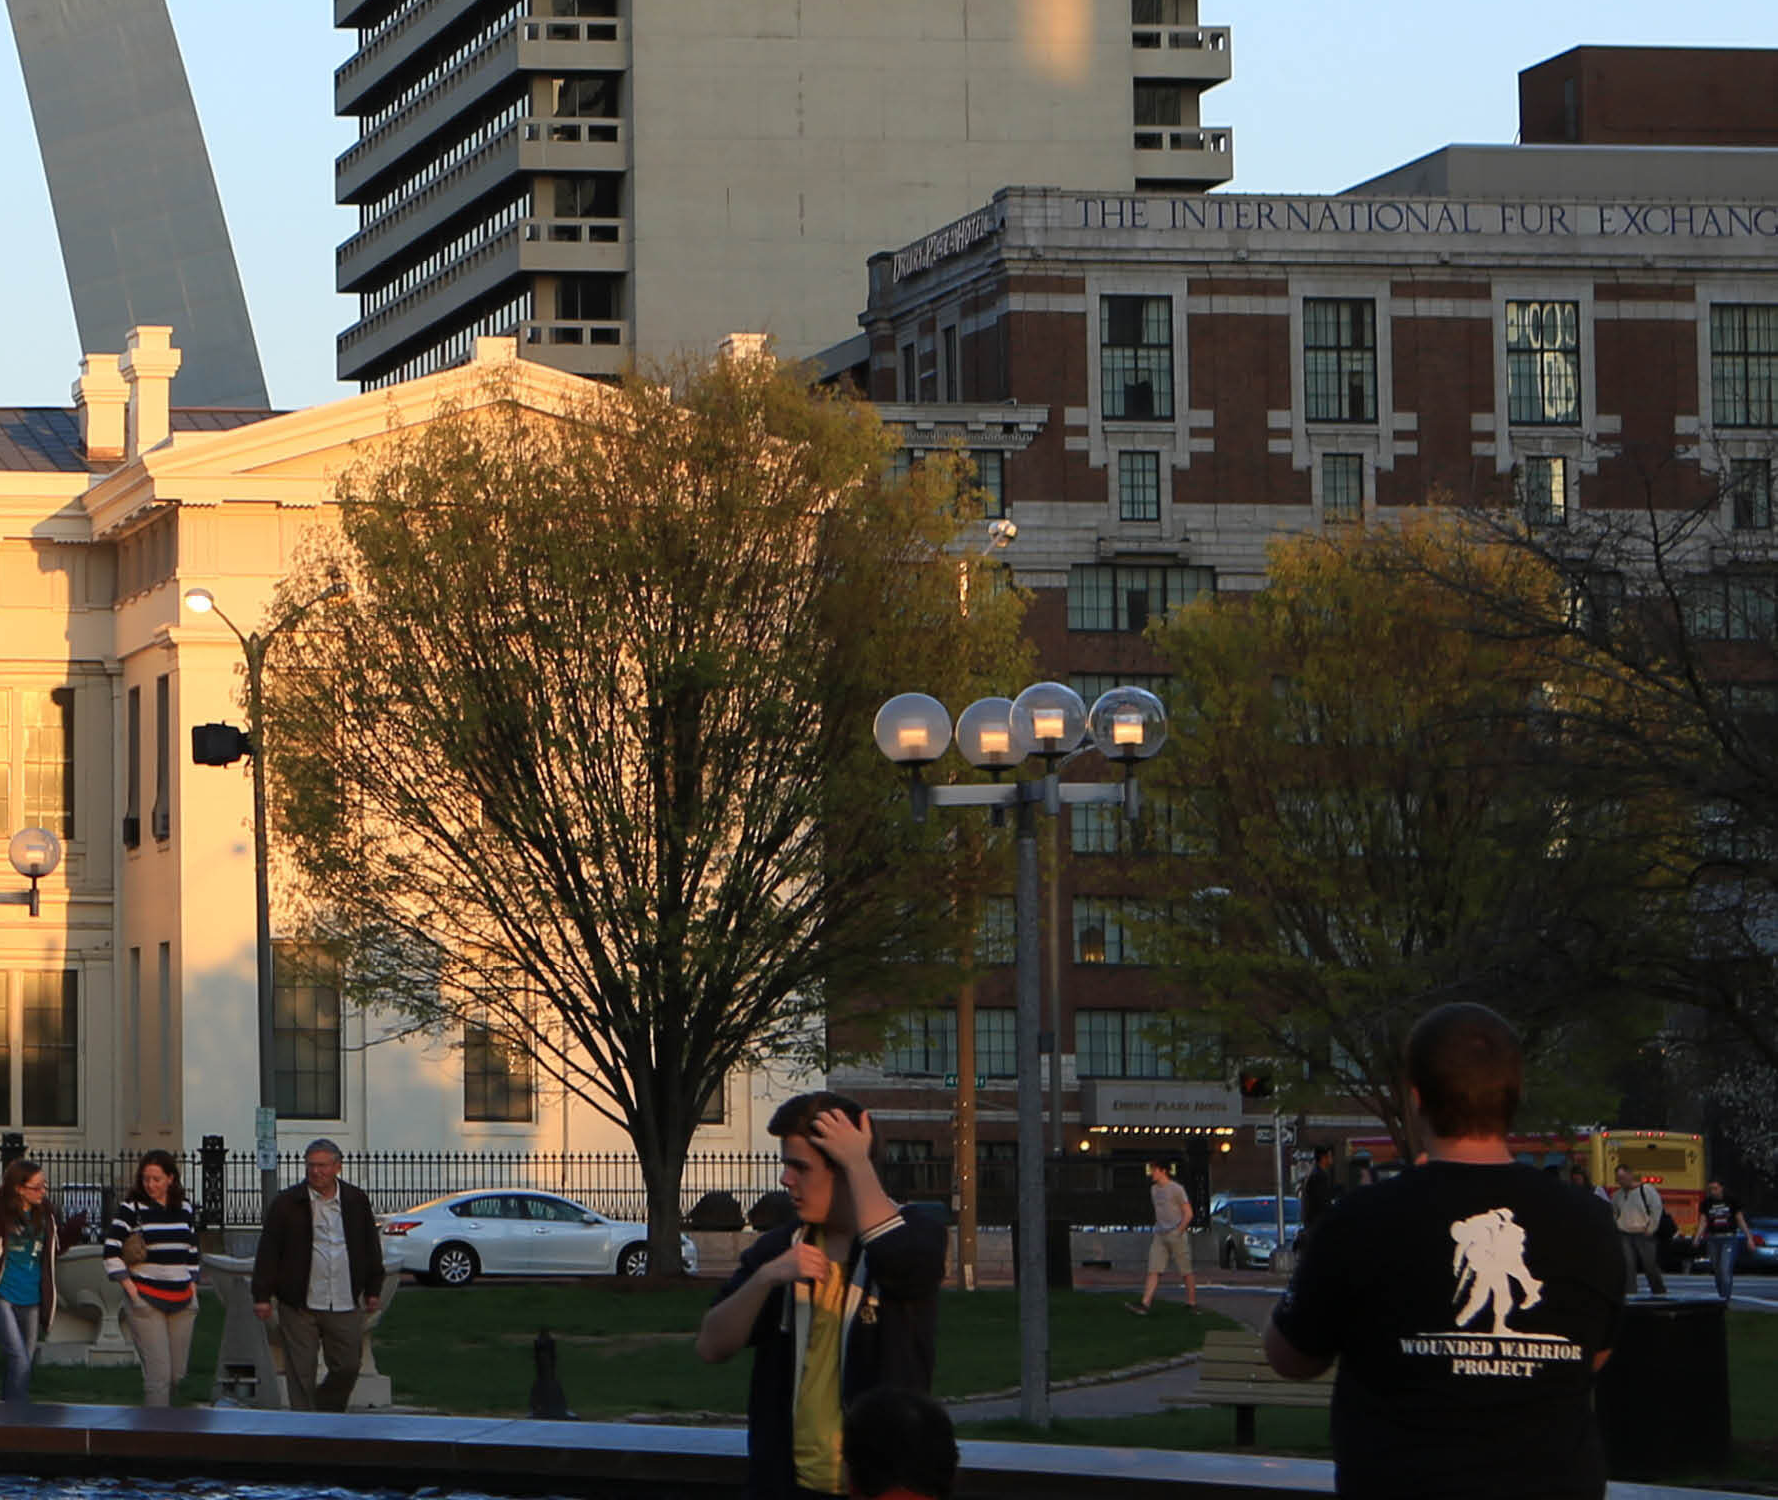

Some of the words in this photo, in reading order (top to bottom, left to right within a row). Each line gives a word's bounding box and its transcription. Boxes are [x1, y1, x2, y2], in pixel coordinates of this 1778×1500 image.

[1075, 199, 1149, 229] THE
[1170, 200, 1481, 233] INTERNATIONAL
[1501, 204, 1573, 234] FUR
[1399, 1339, 1494, 1356] WOUNDED
[1499, 1341, 1582, 1361] WARRIOR
[1452, 1359, 1535, 1378] PROJECT
